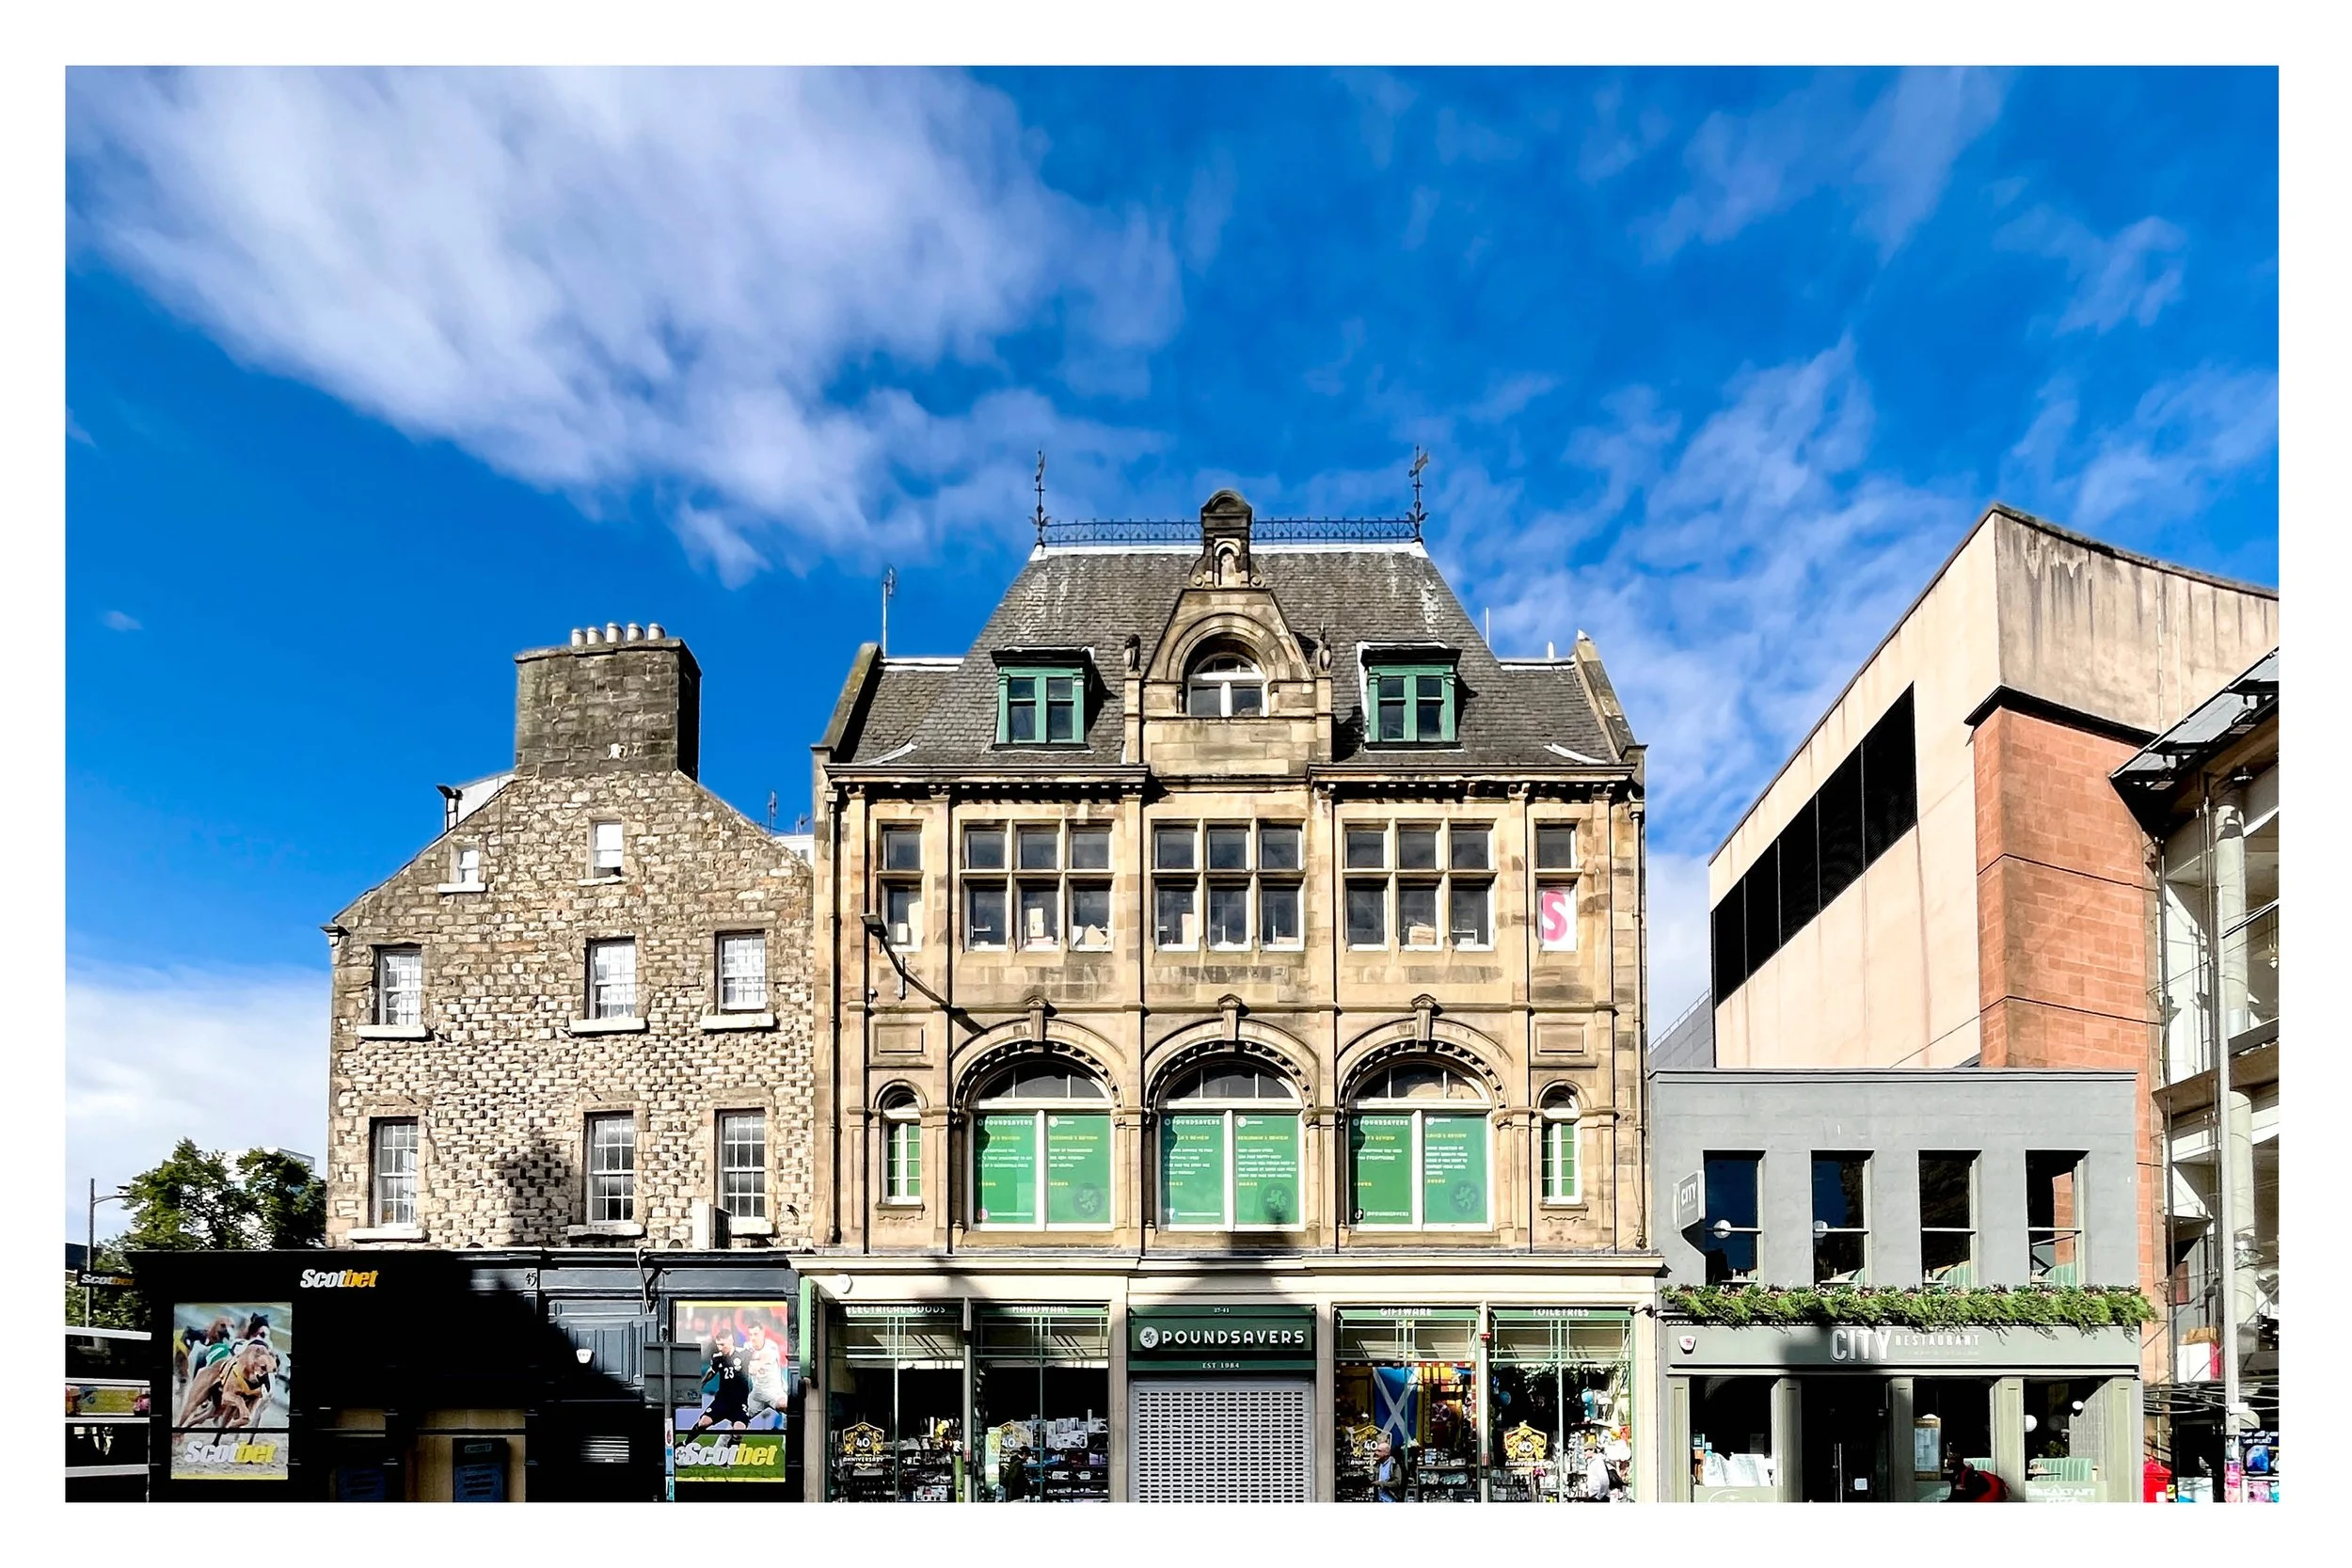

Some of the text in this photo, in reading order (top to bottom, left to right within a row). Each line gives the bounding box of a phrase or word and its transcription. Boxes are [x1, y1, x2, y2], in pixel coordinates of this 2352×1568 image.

[1680, 1181, 1696, 1206] CITY
[300, 1269, 378, 1288] Scotbet
[846, 1306, 908, 1314] ELECTRICAL
[1533, 1308, 1589, 1317] TOILETRIES
[1162, 1330, 1304, 1344] POUNDSAVERS
[1831, 1329, 1979, 1361] CITY RESTAURANT
[723, 1367, 735, 1380] 23
[856, 1437, 870, 1448] 40
[1364, 1440, 1378, 1450] 40
[184, 1440, 276, 1463] Scotbet
[684, 1442, 778, 1465] Scotbet
